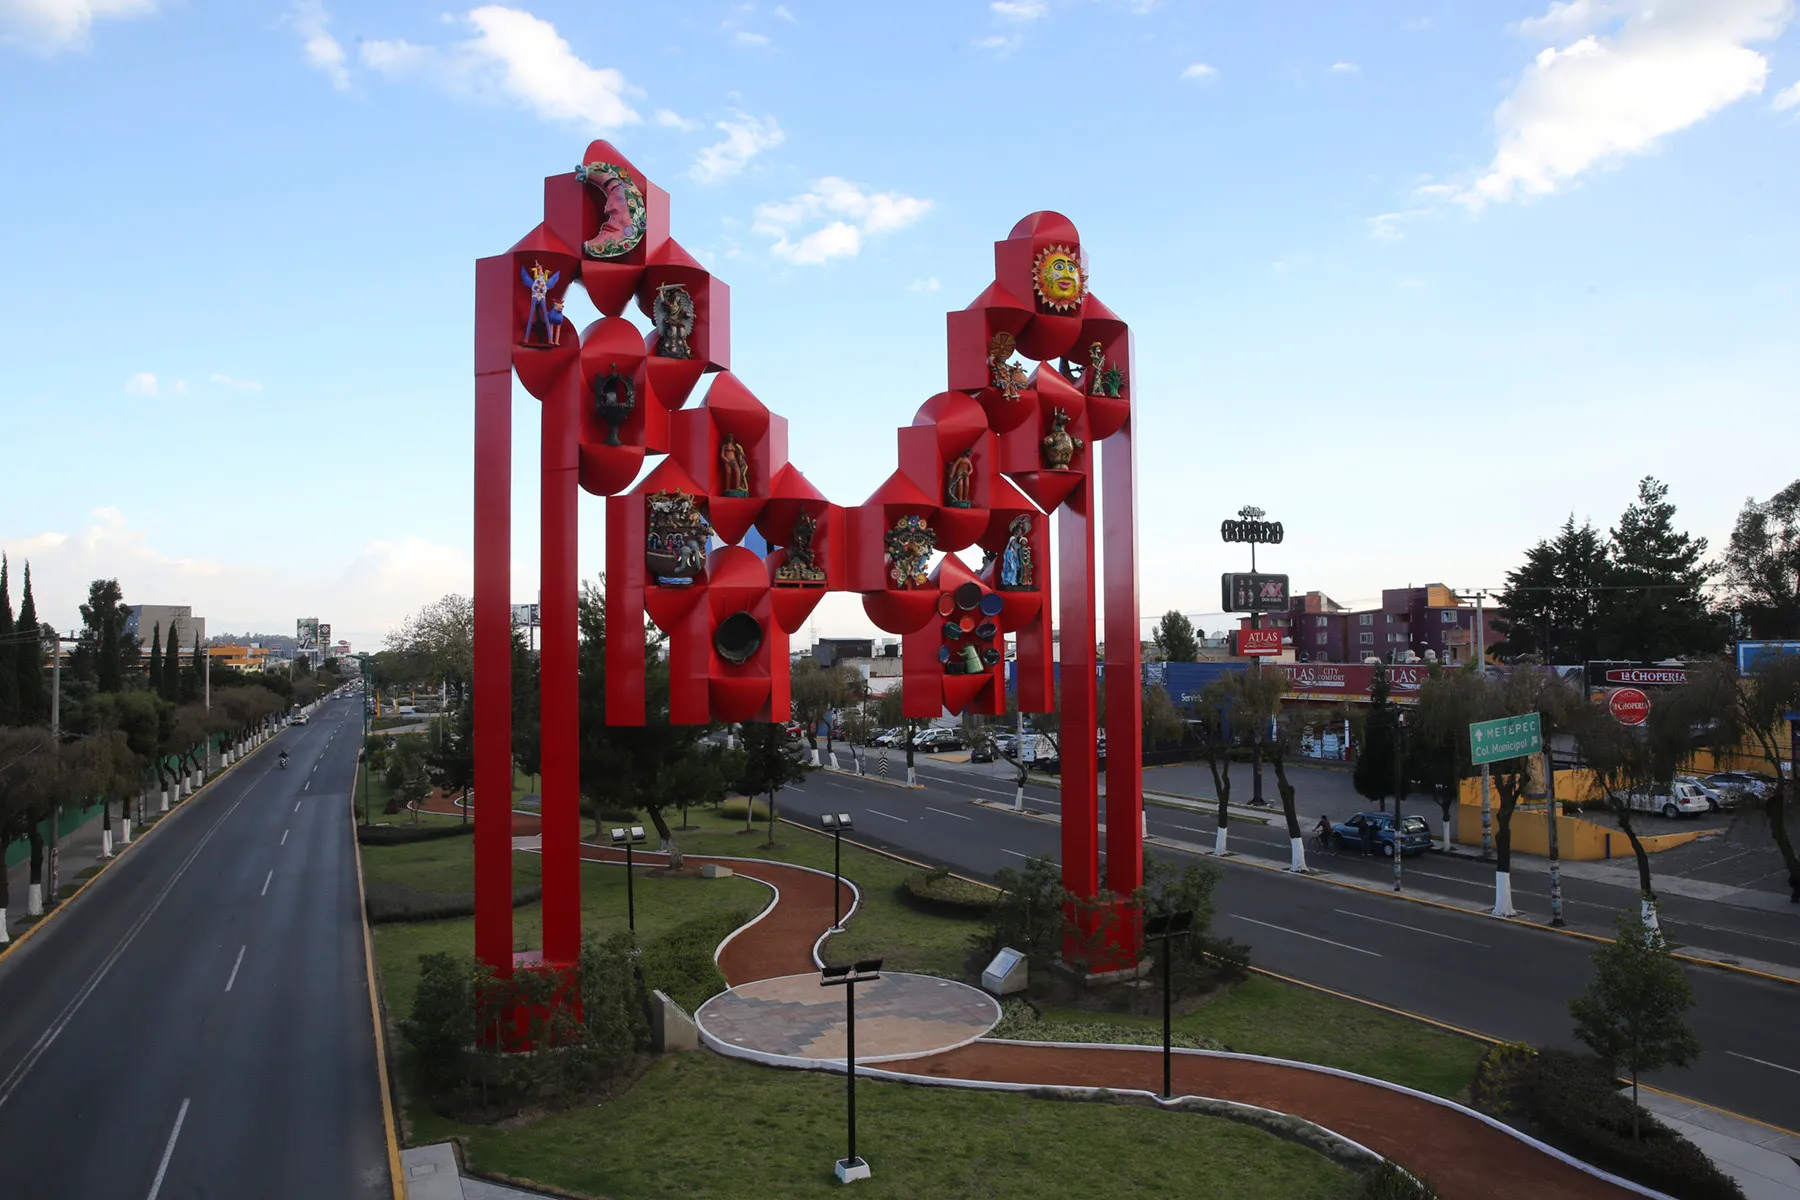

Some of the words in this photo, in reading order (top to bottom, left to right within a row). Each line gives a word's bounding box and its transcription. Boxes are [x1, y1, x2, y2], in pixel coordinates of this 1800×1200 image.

[1249, 632, 1278, 641] ATLAS
[1631, 670, 1687, 681] CHOPERIA
[1618, 702, 1648, 710] CHOPERIA
[1487, 721, 1536, 739] METEPEC
[1492, 738, 1528, 754] Municipal
